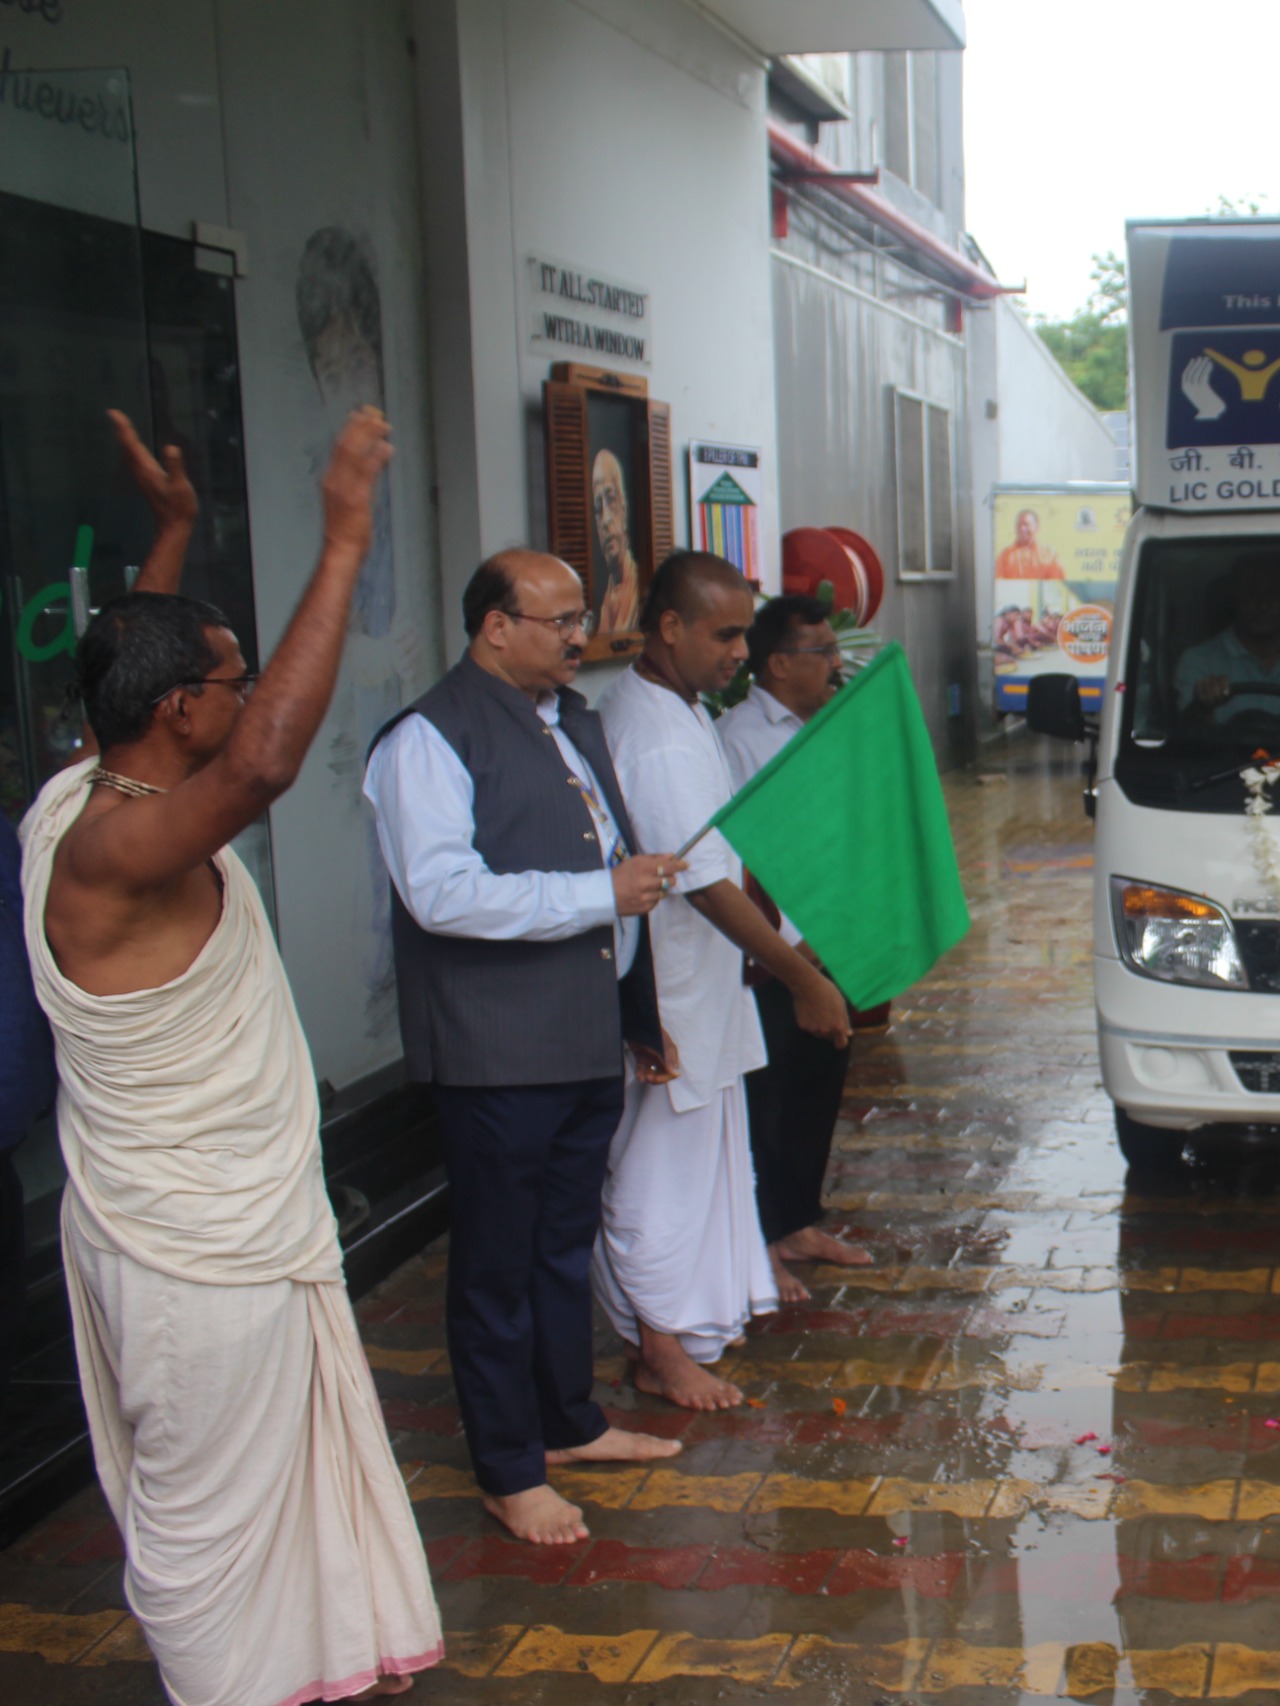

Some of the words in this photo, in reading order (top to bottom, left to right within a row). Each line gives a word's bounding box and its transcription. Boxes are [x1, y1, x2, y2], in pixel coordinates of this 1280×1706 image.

[541, 262, 556, 293] IT
[559, 268, 585, 302] ALL
[587, 278, 644, 318] STARTED
[1223, 294, 1270, 309] This
[543, 311, 582, 347] WITH
[593, 325, 645, 361] WINDOW
[1170, 482, 1208, 503] LIC
